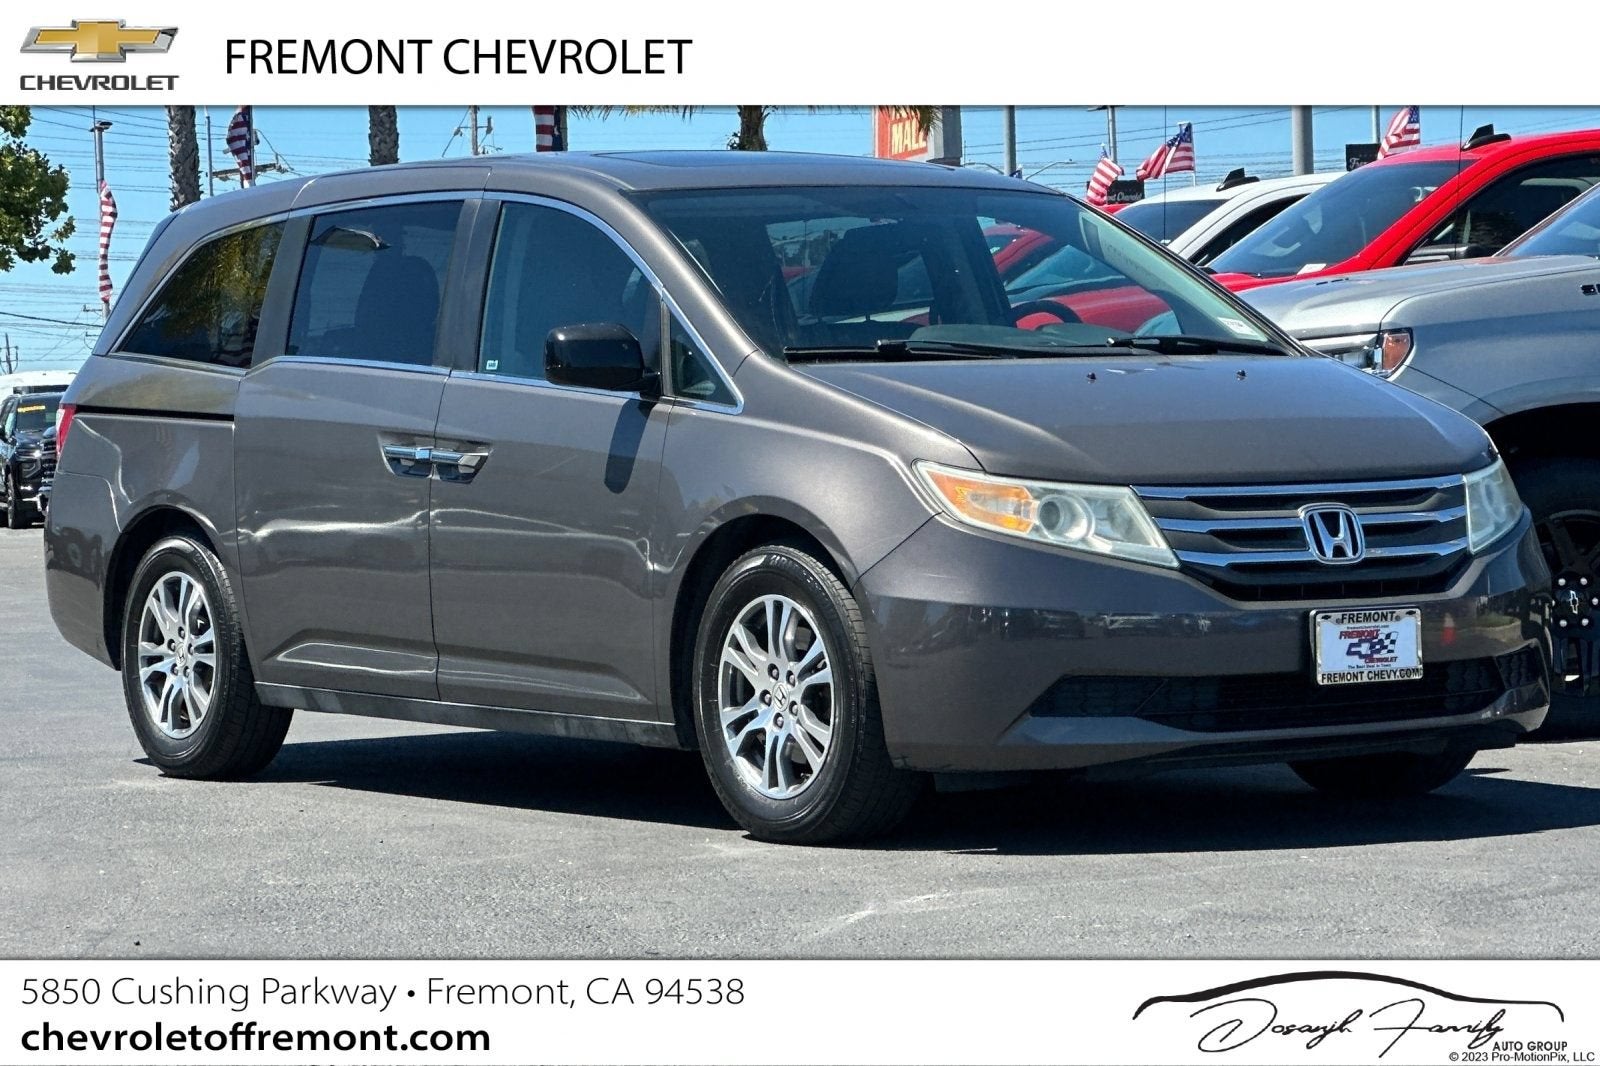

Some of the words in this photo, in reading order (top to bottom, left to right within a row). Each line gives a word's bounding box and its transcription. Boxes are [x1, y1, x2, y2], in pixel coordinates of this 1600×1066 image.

[1341, 611, 1396, 624] FREMONT
[1321, 671, 1365, 684] FREMONT
[1366, 667, 1421, 680] CHEVY.COM
